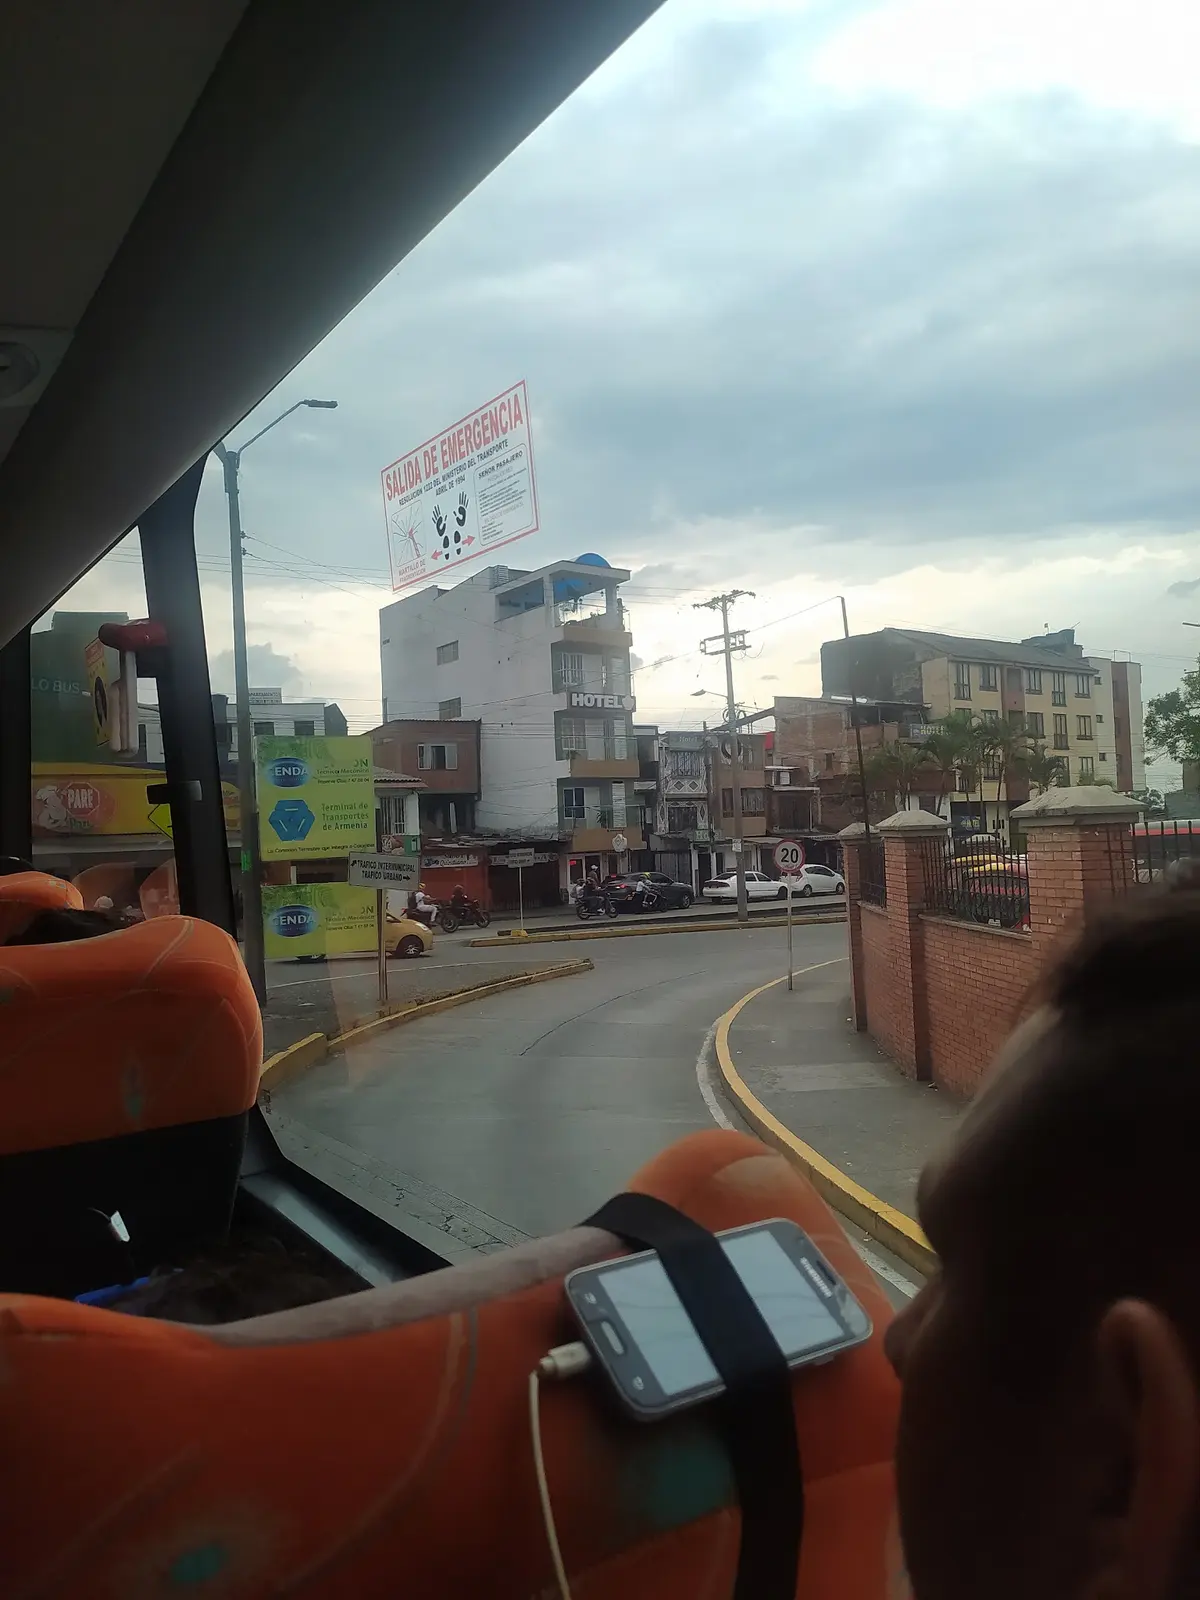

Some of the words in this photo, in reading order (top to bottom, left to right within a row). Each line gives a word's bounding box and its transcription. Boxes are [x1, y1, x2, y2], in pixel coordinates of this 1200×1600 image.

[385, 456, 423, 501] SALIDA
[423, 444, 439, 480] DE
[440, 393, 523, 470] EMERGENCIA
[441, 462, 467, 484] MINISTERIO
[467, 457, 477, 469] DEL
[477, 439, 509, 462] TRANSPORTE
[478, 465, 496, 480] SEÑOR
[495, 450, 523, 471] PASAJERO
[435, 483, 448, 496] ABRIL
[448, 480, 455, 490] DE
[398, 561, 420, 576] MARTILLO
[53, 680, 80, 694] BUS
[571, 693, 623, 708] HOTEL
[67, 788, 94, 809] PARE
[321, 803, 356, 811] Terminal
[359, 802, 368, 810] de
[322, 812, 369, 822] Transportes
[322, 823, 332, 831] de
[334, 821, 368, 830] Armenia
[780, 847, 799, 863] 20
[357, 859, 377, 870] TRAFICO
[377, 861, 416, 873] INTERMUNICIPAL
[361, 870, 382, 880] TRAFICO
[382, 872, 403, 882] URBANO
